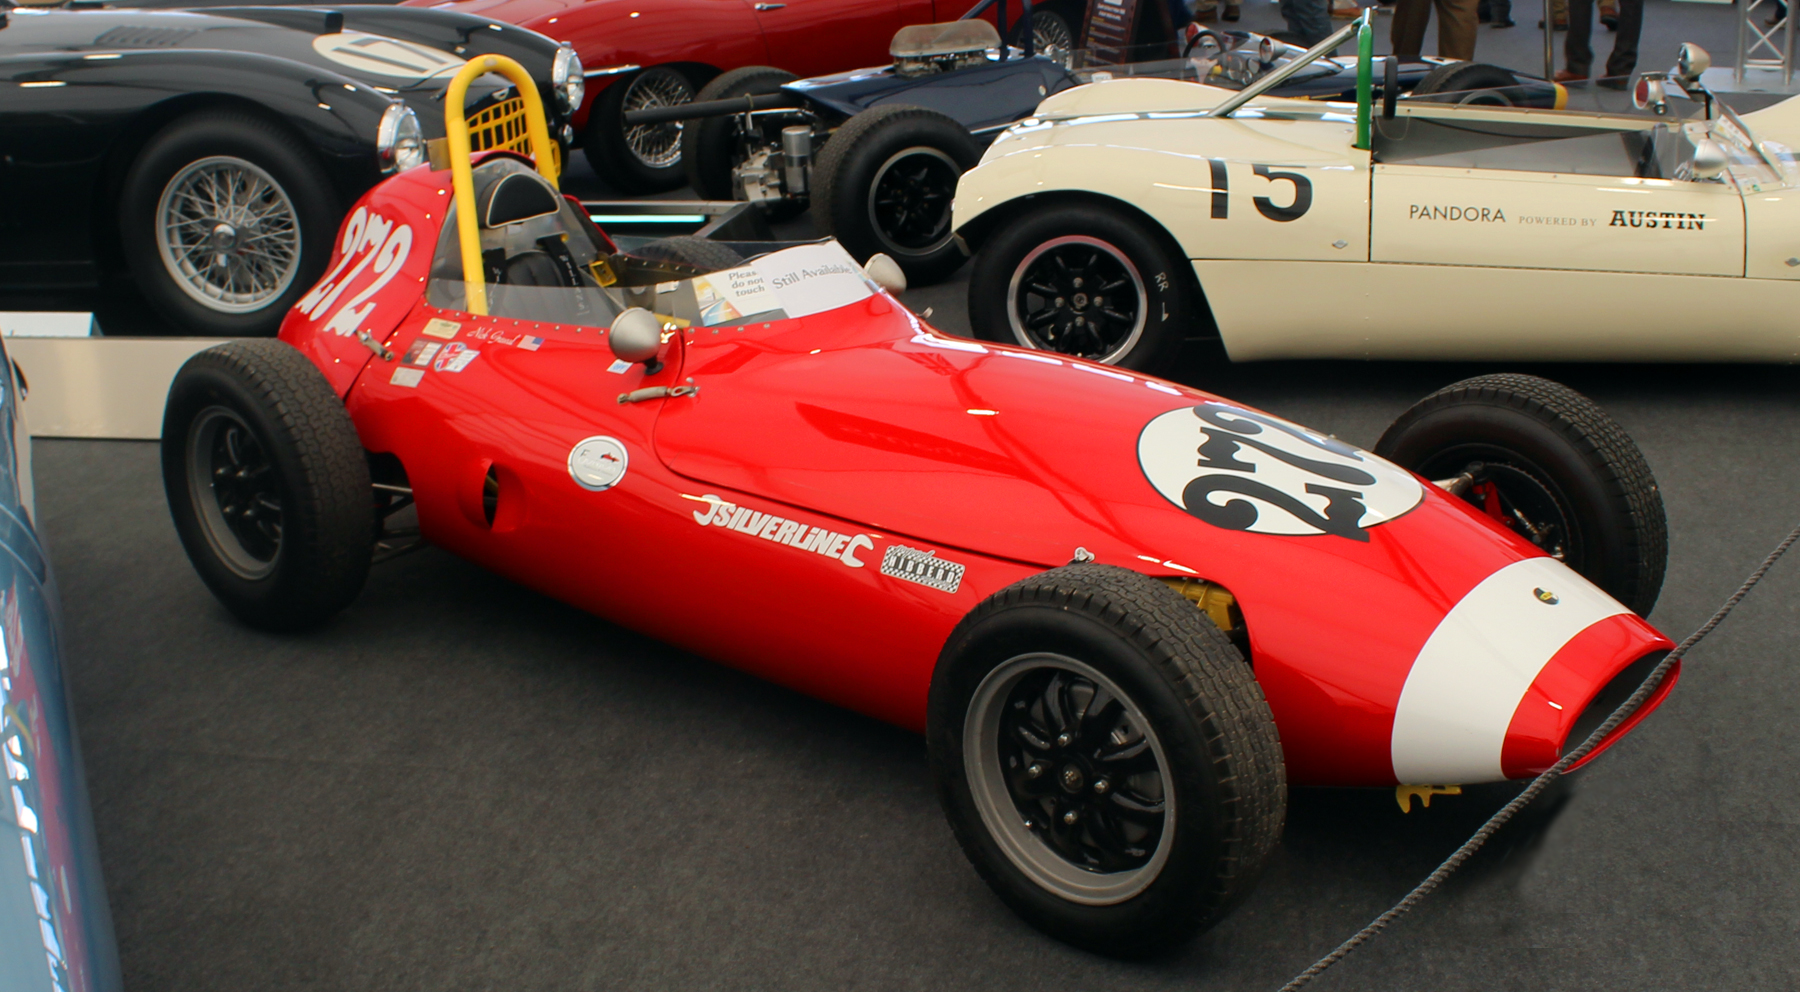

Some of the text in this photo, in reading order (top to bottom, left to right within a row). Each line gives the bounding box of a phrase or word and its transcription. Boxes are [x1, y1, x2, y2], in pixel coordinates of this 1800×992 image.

[332, 36, 449, 74] 17
[1208, 159, 1313, 222] 15
[1409, 204, 1706, 230] PANDORA POWERED BY AUSTIN
[295, 206, 413, 337] 272
[732, 278, 745, 289] do
[772, 263, 853, 290] Still Available
[1155, 271, 1169, 292] RR
[735, 286, 765, 298] touch
[1182, 404, 1377, 543] 272
[888, 555, 956, 584] HIBBERD
